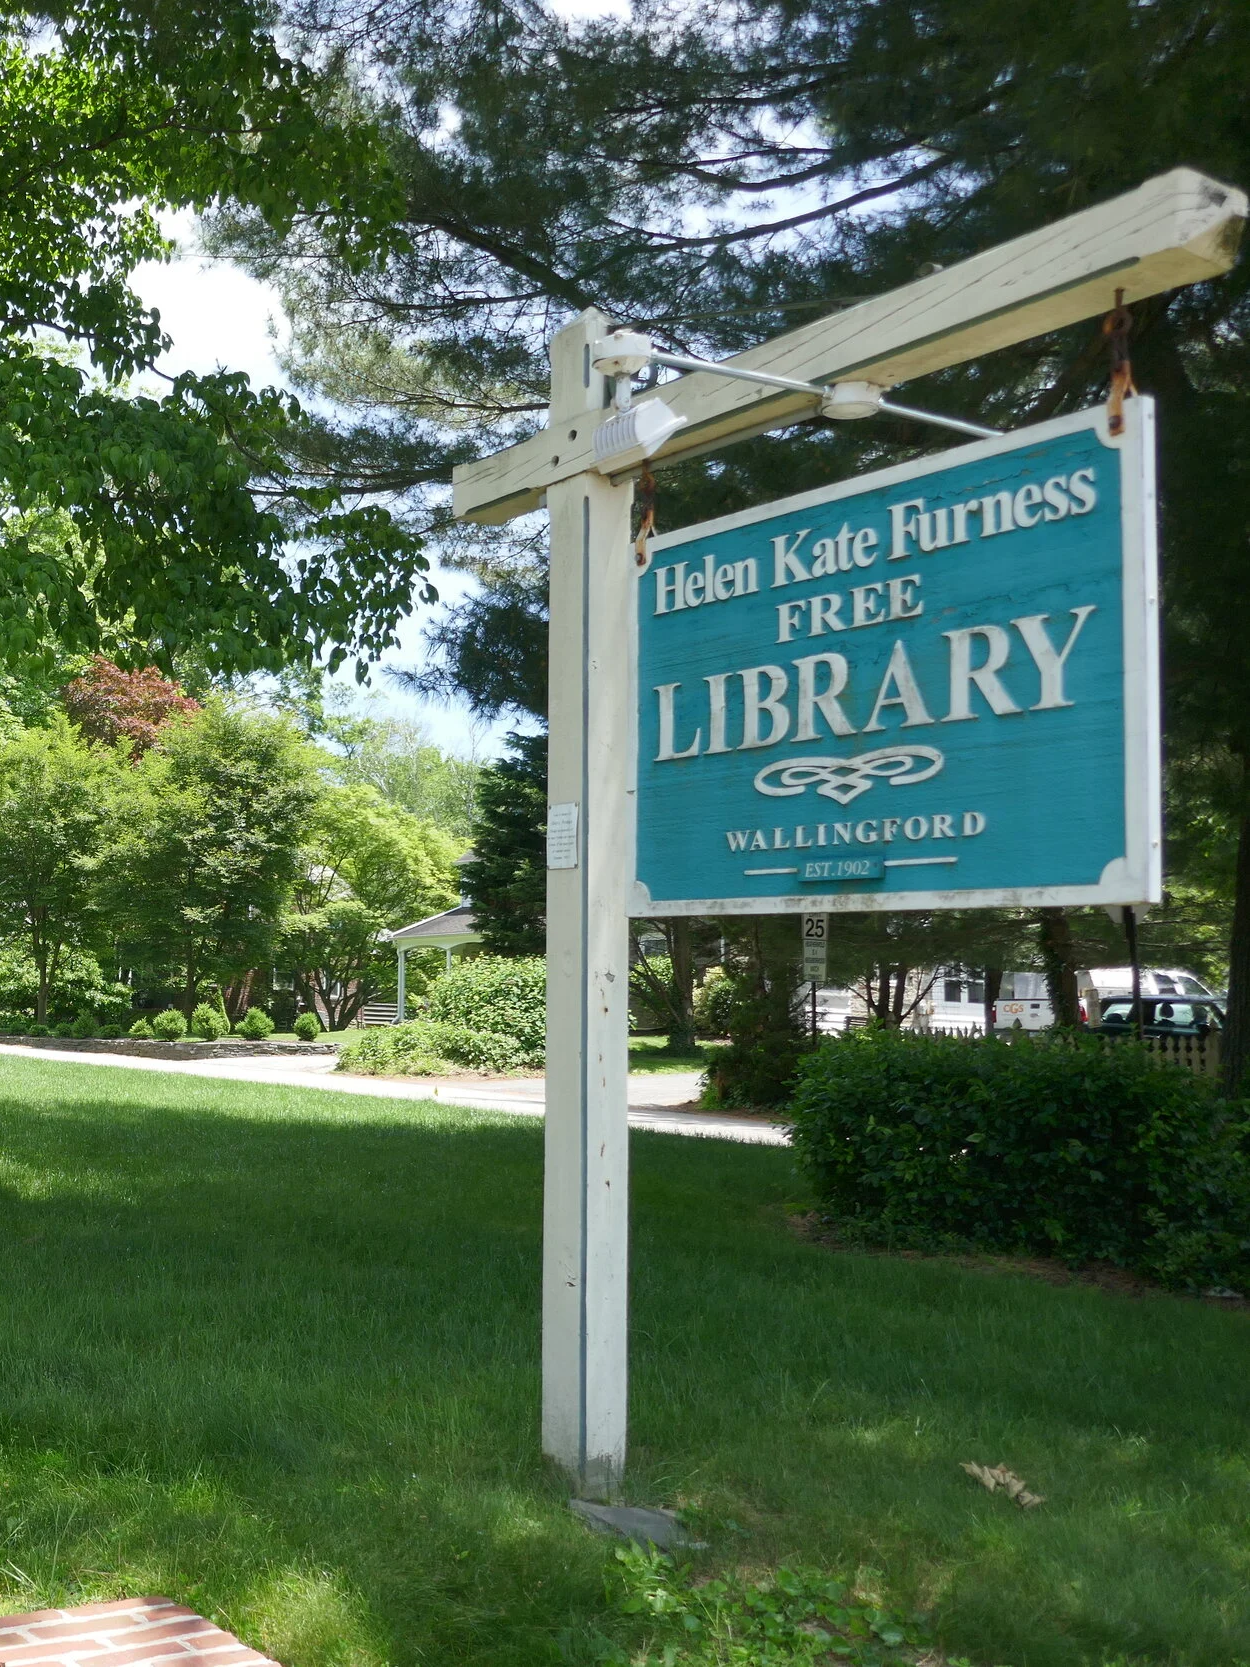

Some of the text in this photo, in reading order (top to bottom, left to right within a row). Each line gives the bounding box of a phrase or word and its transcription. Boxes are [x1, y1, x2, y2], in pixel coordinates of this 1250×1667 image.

[653, 467, 1097, 616] Helen Kate Furness
[774, 573, 925, 644] FREE
[652, 604, 1097, 762] LIBRARY
[726, 811, 986, 852] WALLINGFORD
[805, 918, 825, 938] 25
